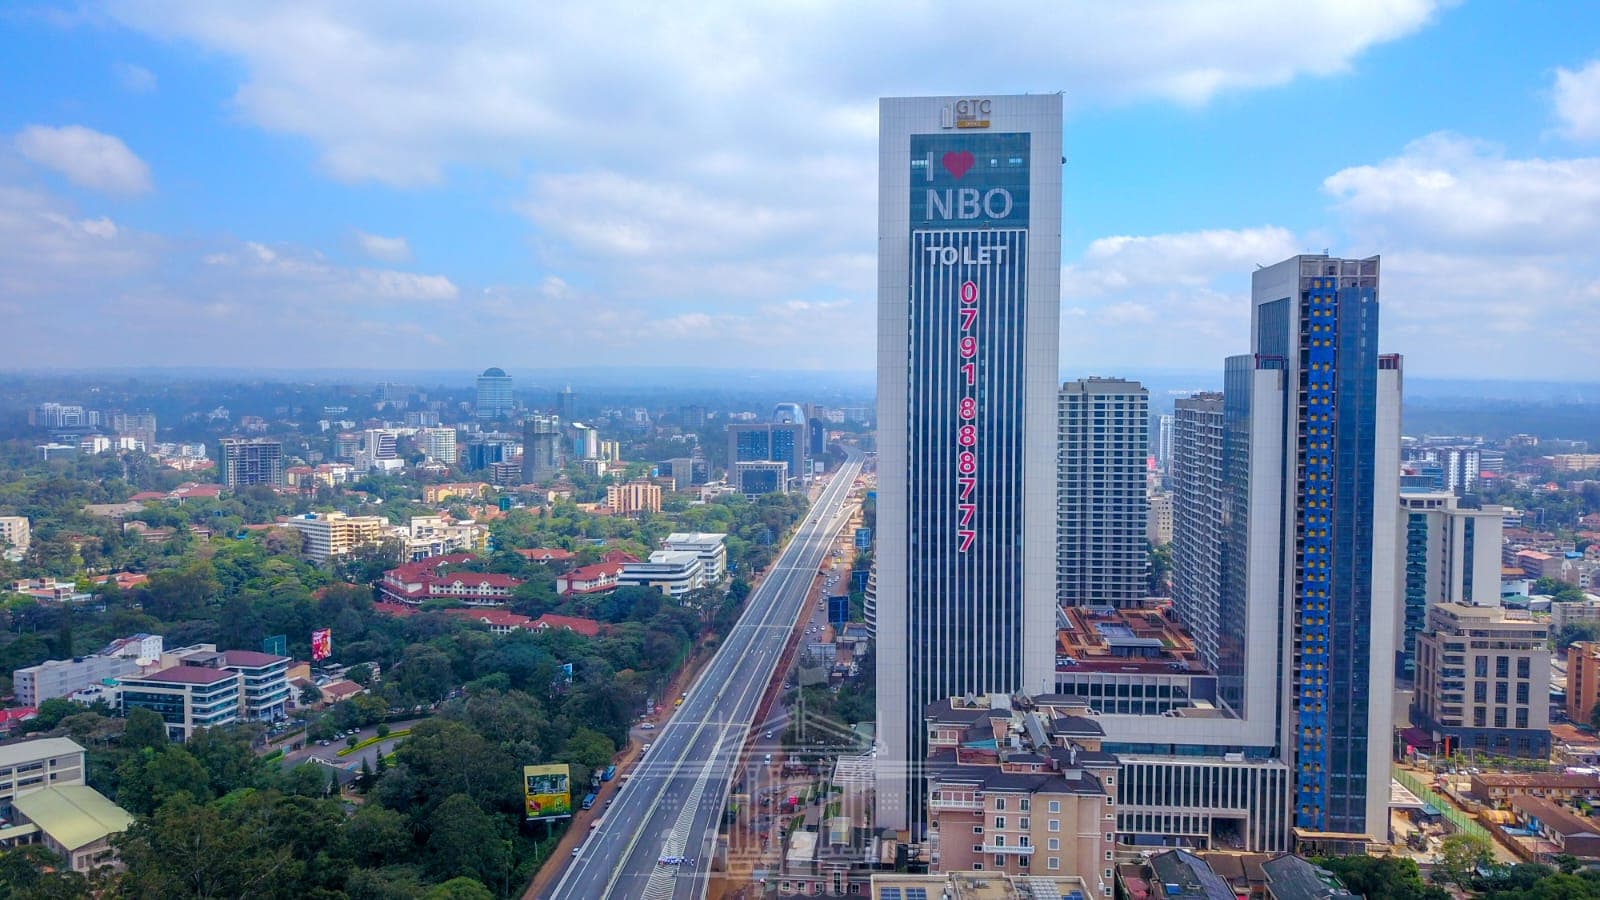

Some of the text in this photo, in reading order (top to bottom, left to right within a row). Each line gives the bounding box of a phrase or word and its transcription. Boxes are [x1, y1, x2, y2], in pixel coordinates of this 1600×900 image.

[956, 99, 992, 114] GTC
[927, 152, 934, 182] I
[927, 188, 1013, 221] NBO
[926, 246, 1008, 265] TO LET
